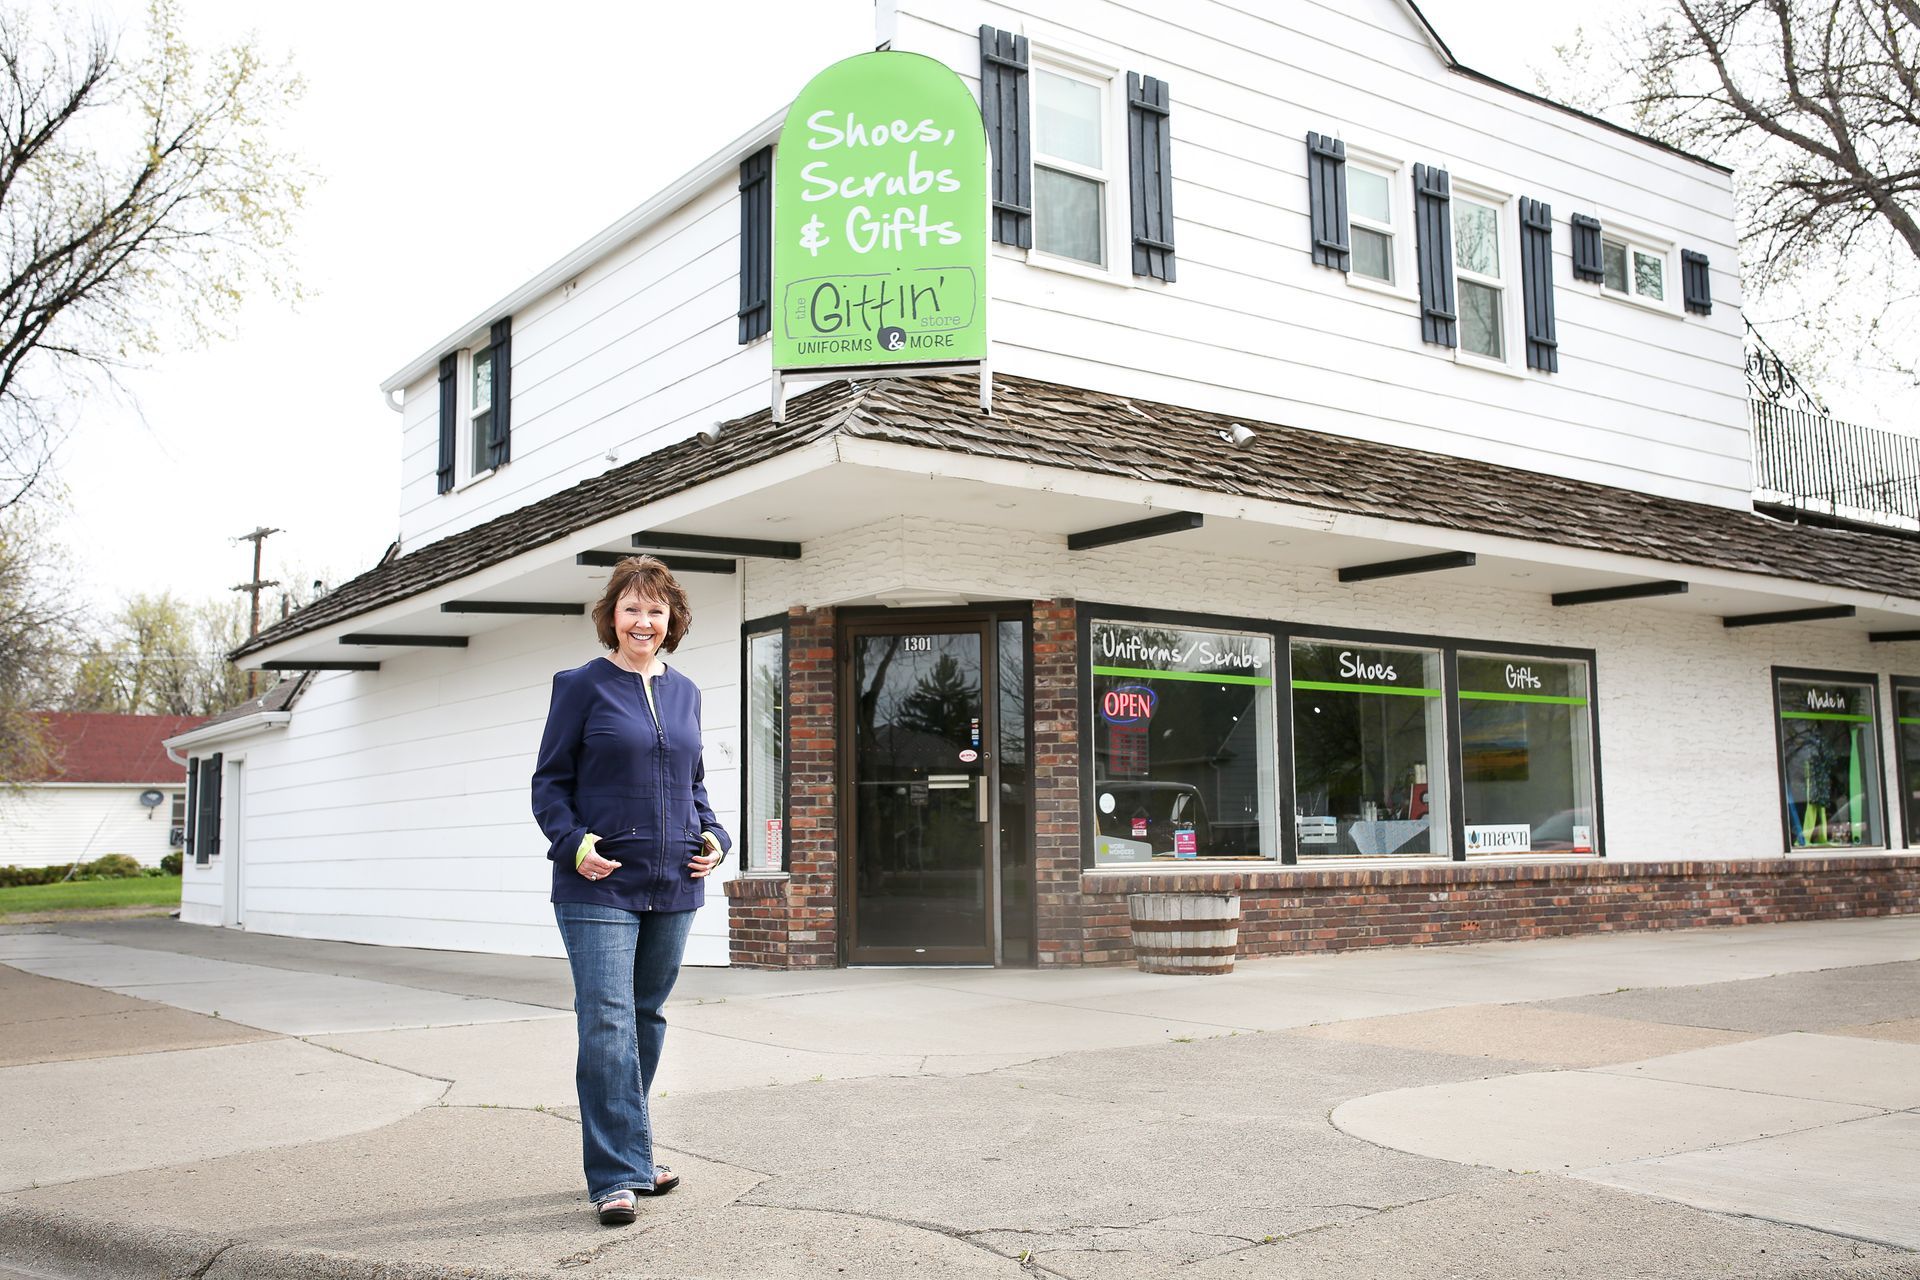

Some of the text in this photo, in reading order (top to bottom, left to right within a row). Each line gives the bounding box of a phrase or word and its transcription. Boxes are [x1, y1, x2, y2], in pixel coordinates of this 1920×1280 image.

[806, 110, 955, 151] Shoes,
[800, 151, 961, 202] Scrubs
[799, 205, 962, 256] & Gifts
[795, 297, 806, 320] the
[920, 313, 961, 327] store
[798, 332, 954, 355] UNIFORMS & MORE
[904, 637, 932, 651] 1301
[1103, 630, 1263, 669] Uniforms/Scrubs
[1339, 651, 1398, 681] Shoes
[1505, 664, 1542, 689] Gifts
[1104, 691, 1151, 719] OPEN
[1807, 688, 1846, 709] Made in
[1482, 830, 1528, 847] mævn
